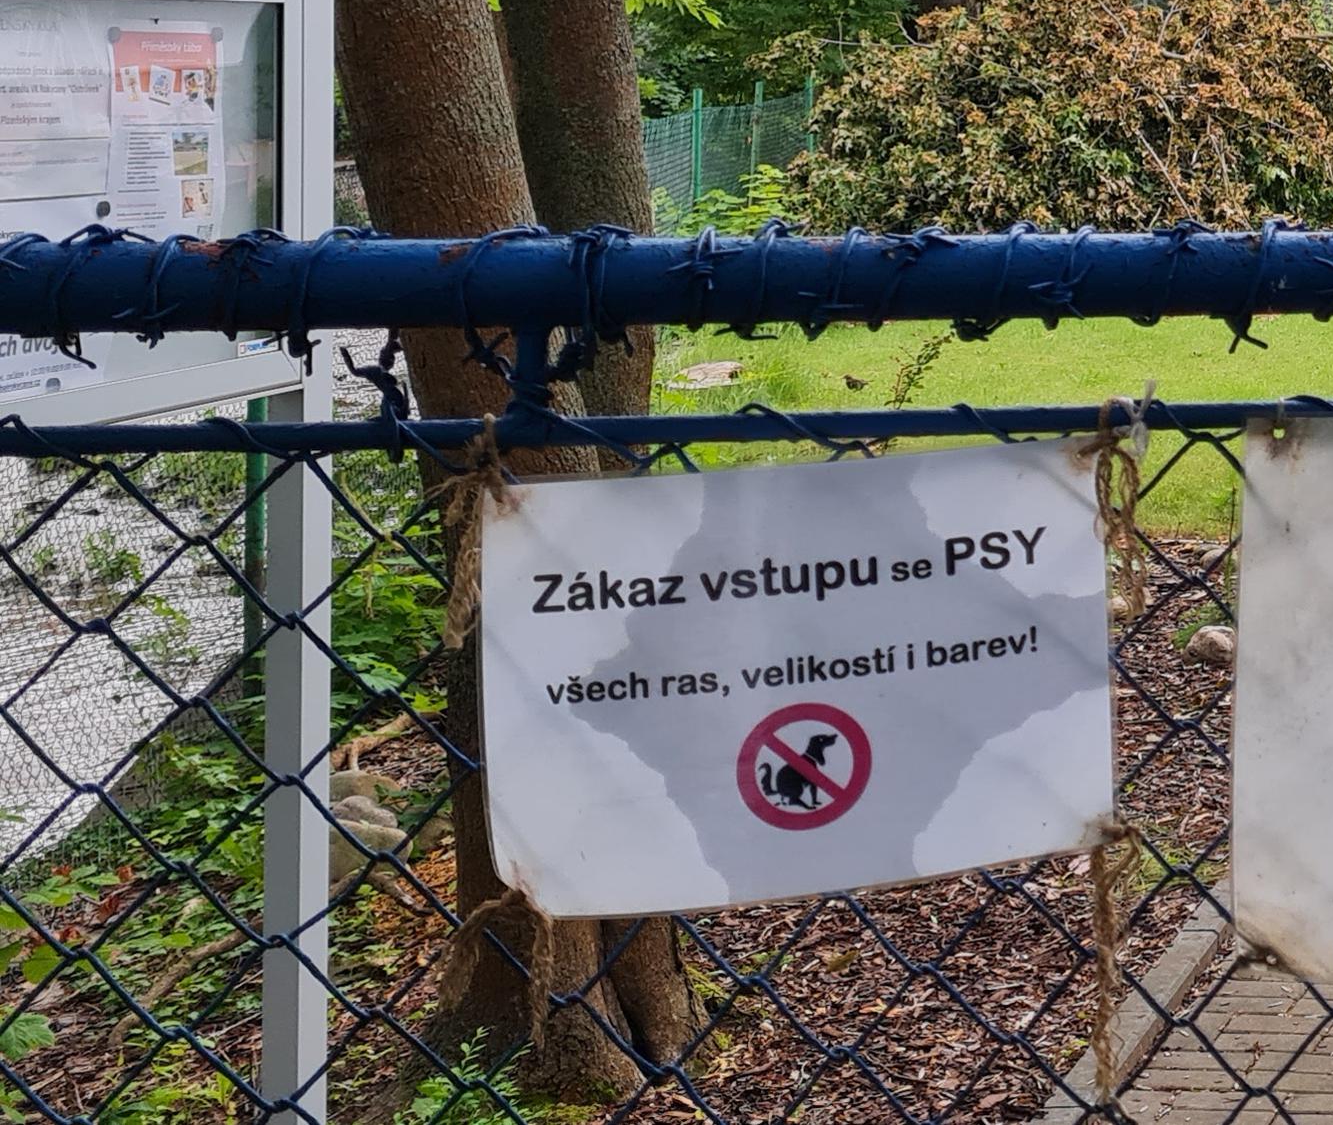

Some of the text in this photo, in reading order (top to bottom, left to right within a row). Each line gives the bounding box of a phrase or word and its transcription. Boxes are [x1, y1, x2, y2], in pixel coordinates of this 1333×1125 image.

[531, 526, 1046, 615] Zákaz vstupu se PSY
[546, 626, 1039, 705] všech ras, velikostí i barev!
